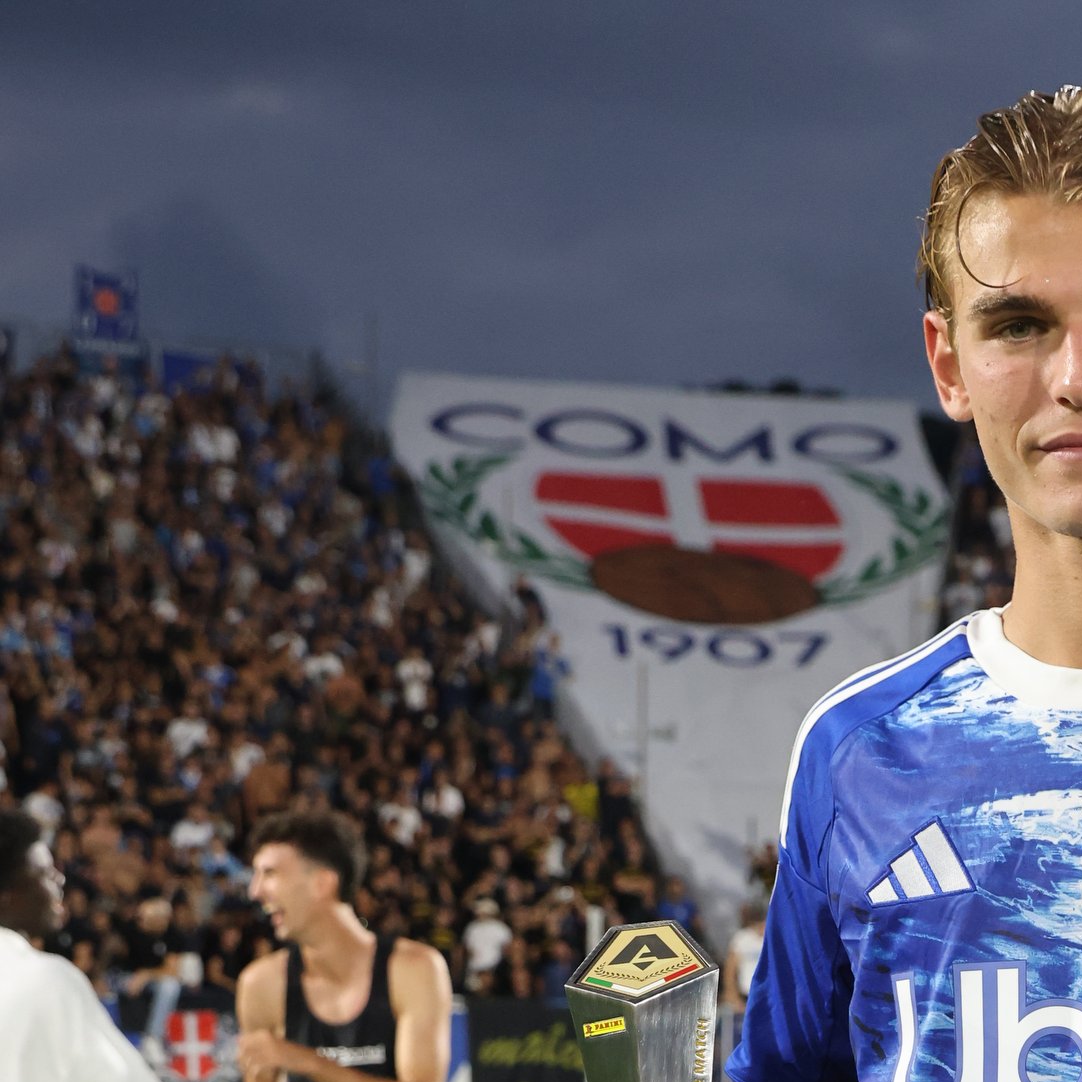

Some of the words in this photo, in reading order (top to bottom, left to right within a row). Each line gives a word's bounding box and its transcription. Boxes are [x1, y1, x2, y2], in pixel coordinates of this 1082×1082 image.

[431, 403, 898, 464] COMO
[606, 622, 832, 668] 1907
[594, 1019, 623, 1031] PANINI
[694, 1017, 711, 1075] MATCH
